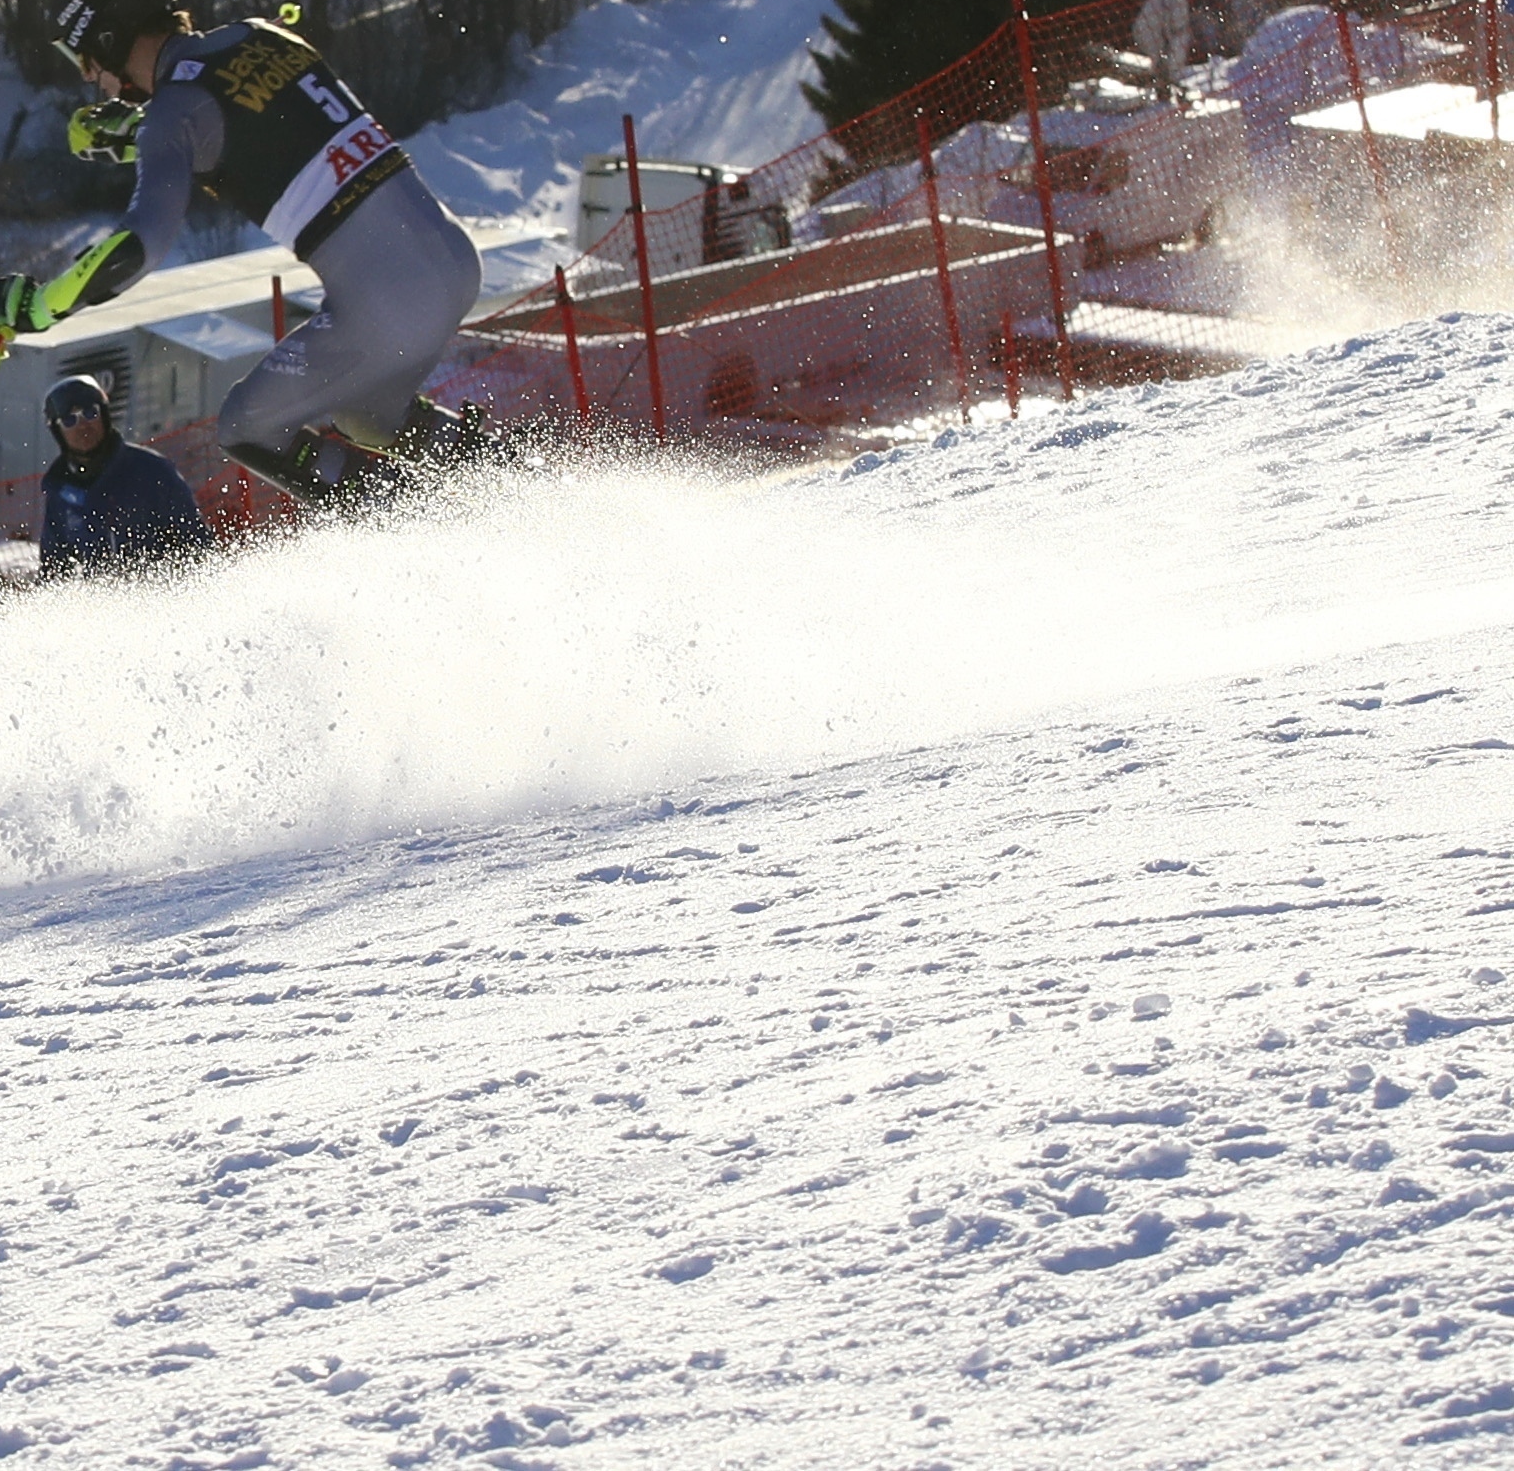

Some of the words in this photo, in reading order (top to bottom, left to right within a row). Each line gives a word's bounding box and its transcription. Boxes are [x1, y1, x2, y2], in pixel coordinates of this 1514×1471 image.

[67, 5, 95, 47] uvex
[215, 40, 277, 96] Jack
[233, 45, 322, 113] Wolfsk
[297, 73, 350, 124] 5
